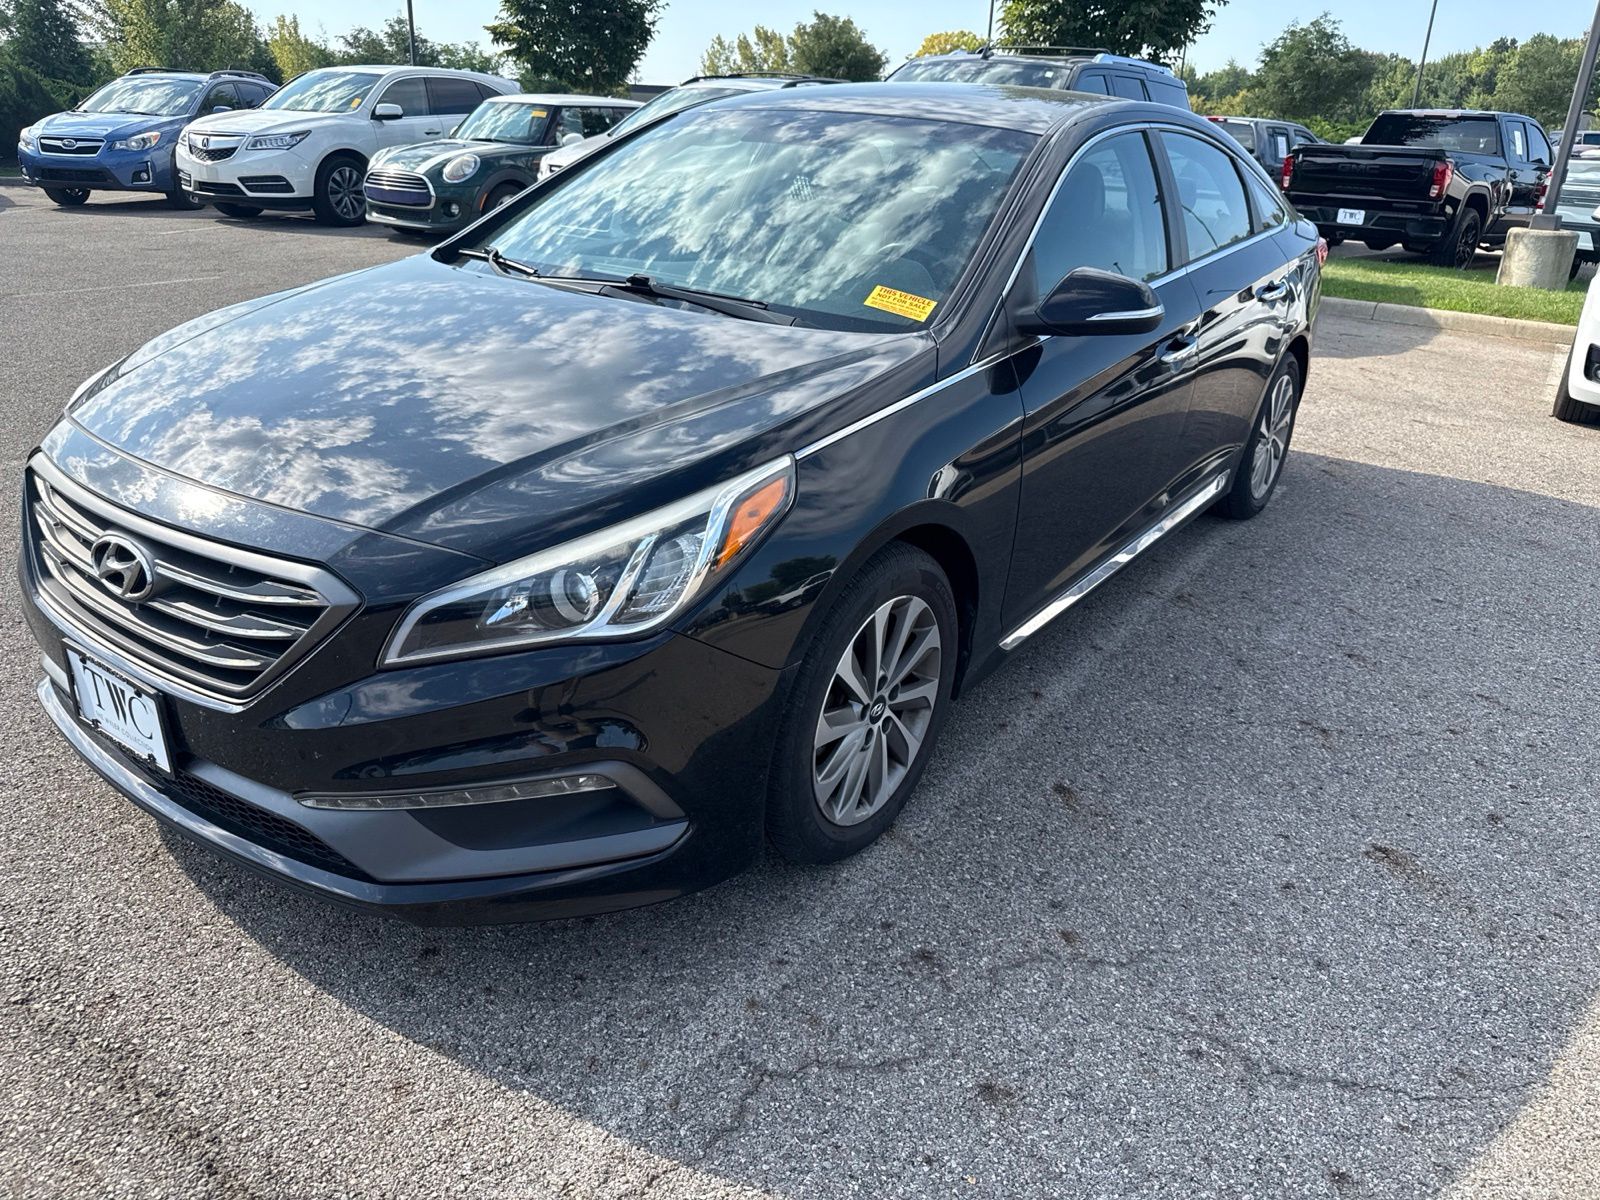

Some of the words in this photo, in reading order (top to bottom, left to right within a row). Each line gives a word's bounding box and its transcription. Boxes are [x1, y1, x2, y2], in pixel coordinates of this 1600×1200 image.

[1338, 163, 1380, 174] GMC
[1343, 210, 1360, 221] TWC
[876, 292, 891, 300] NOT
[909, 302, 926, 310] SALE
[879, 288, 896, 296] THIS
[900, 293, 931, 306] VEHICLE
[83, 665, 153, 740] TWC
